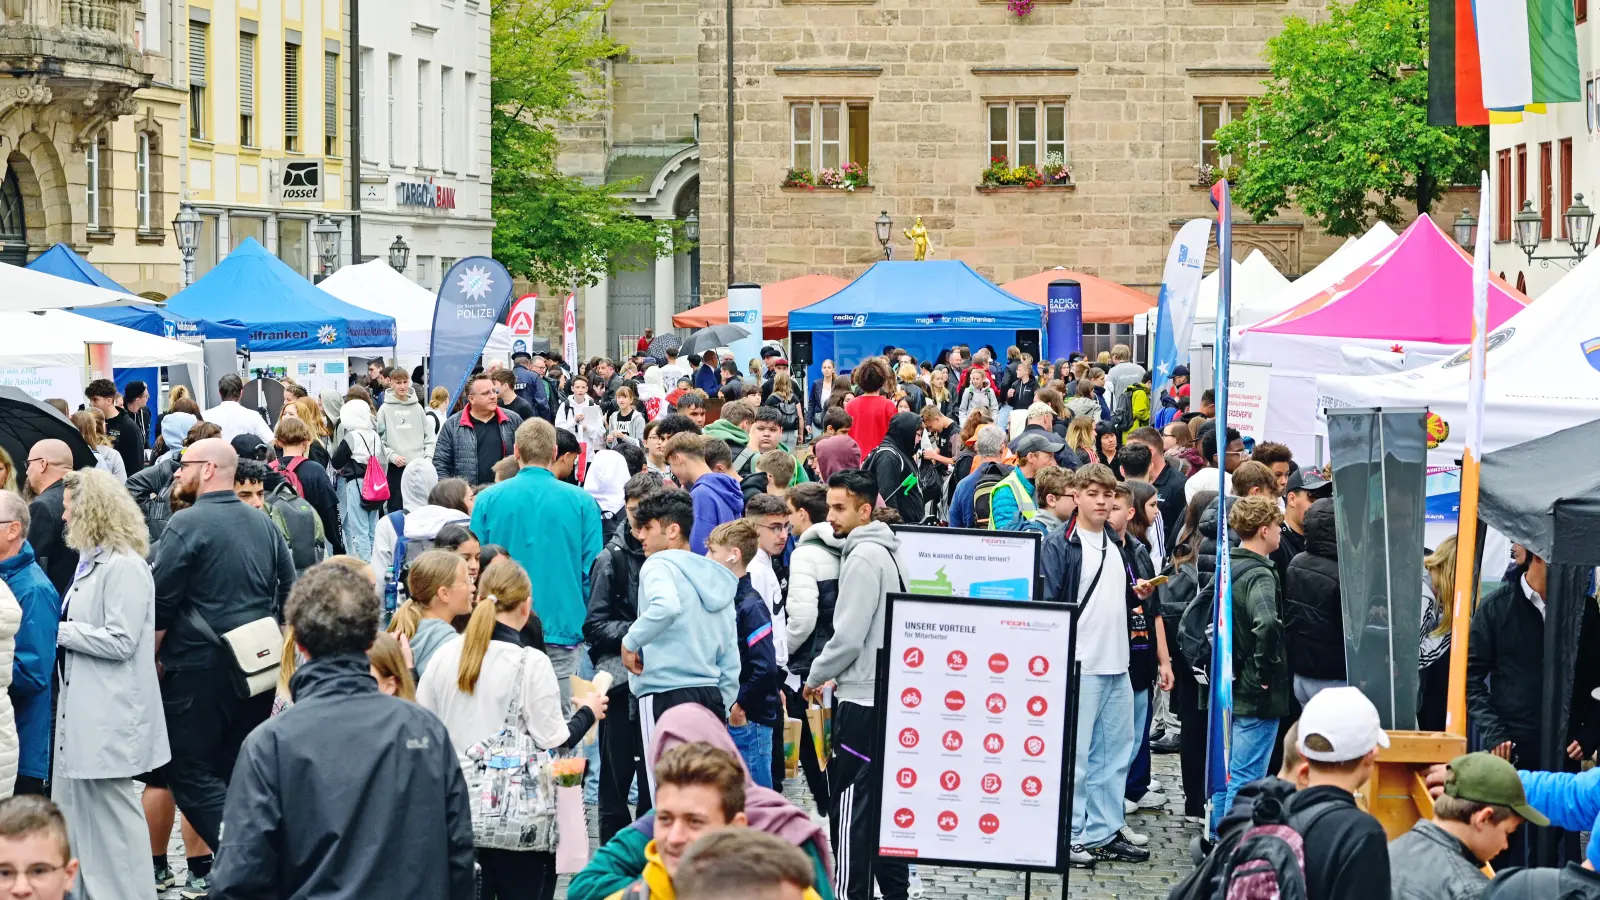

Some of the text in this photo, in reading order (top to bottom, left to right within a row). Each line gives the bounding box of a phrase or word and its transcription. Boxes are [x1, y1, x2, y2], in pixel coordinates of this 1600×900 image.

[283, 187, 318, 198] rosset
[457, 308, 495, 319] POLIZEI
[855, 315, 865, 326] 8
[14, 377, 52, 387] Ausbildung
[932, 552, 954, 560] kannst
[987, 555, 1011, 563] lernen?
[905, 621, 977, 634] UNSERE VORTEILE
[914, 632, 948, 641] Mitarbeiter
